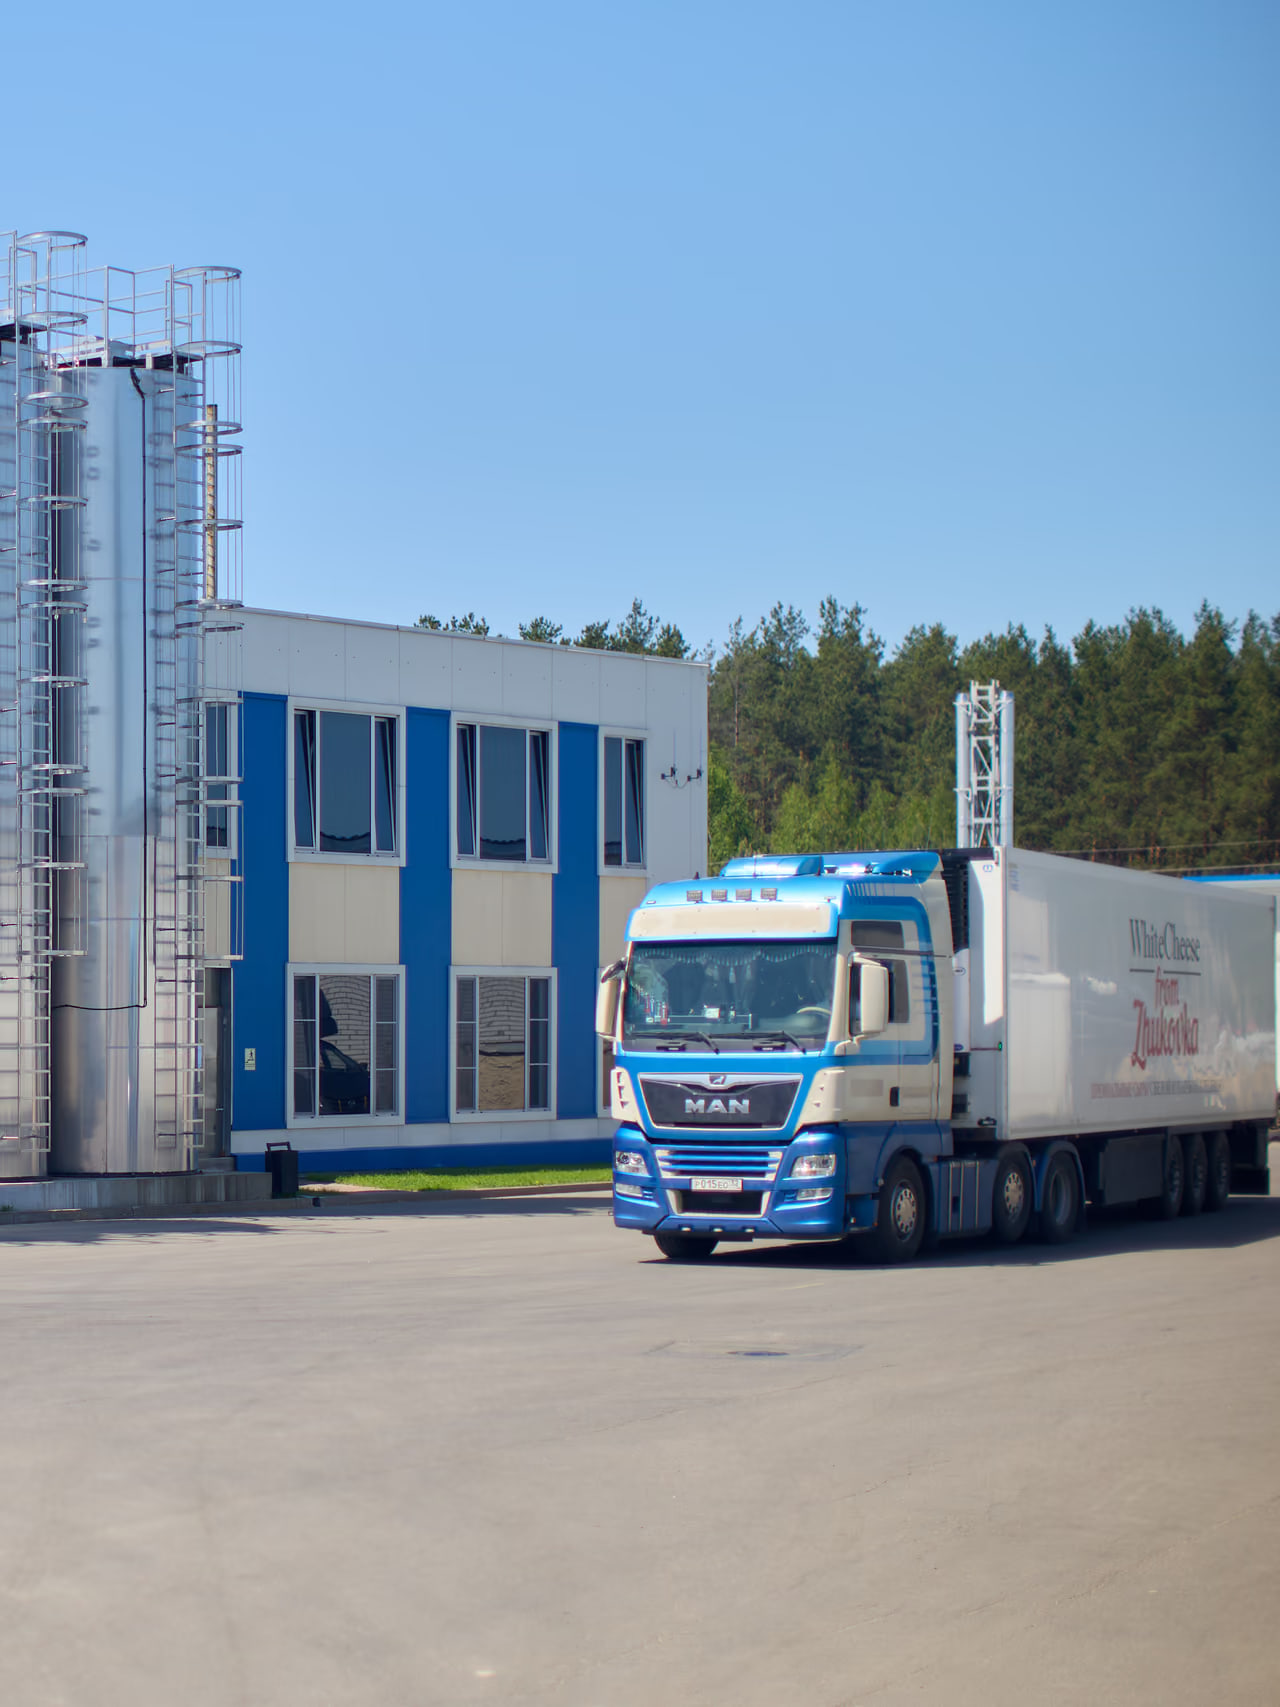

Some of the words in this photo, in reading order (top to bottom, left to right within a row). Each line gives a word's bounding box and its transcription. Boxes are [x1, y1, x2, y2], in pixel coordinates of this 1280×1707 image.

[1155, 965, 1180, 1008] from
[1130, 998, 1199, 1070] Zhukovka
[684, 1099, 751, 1113] MAN
